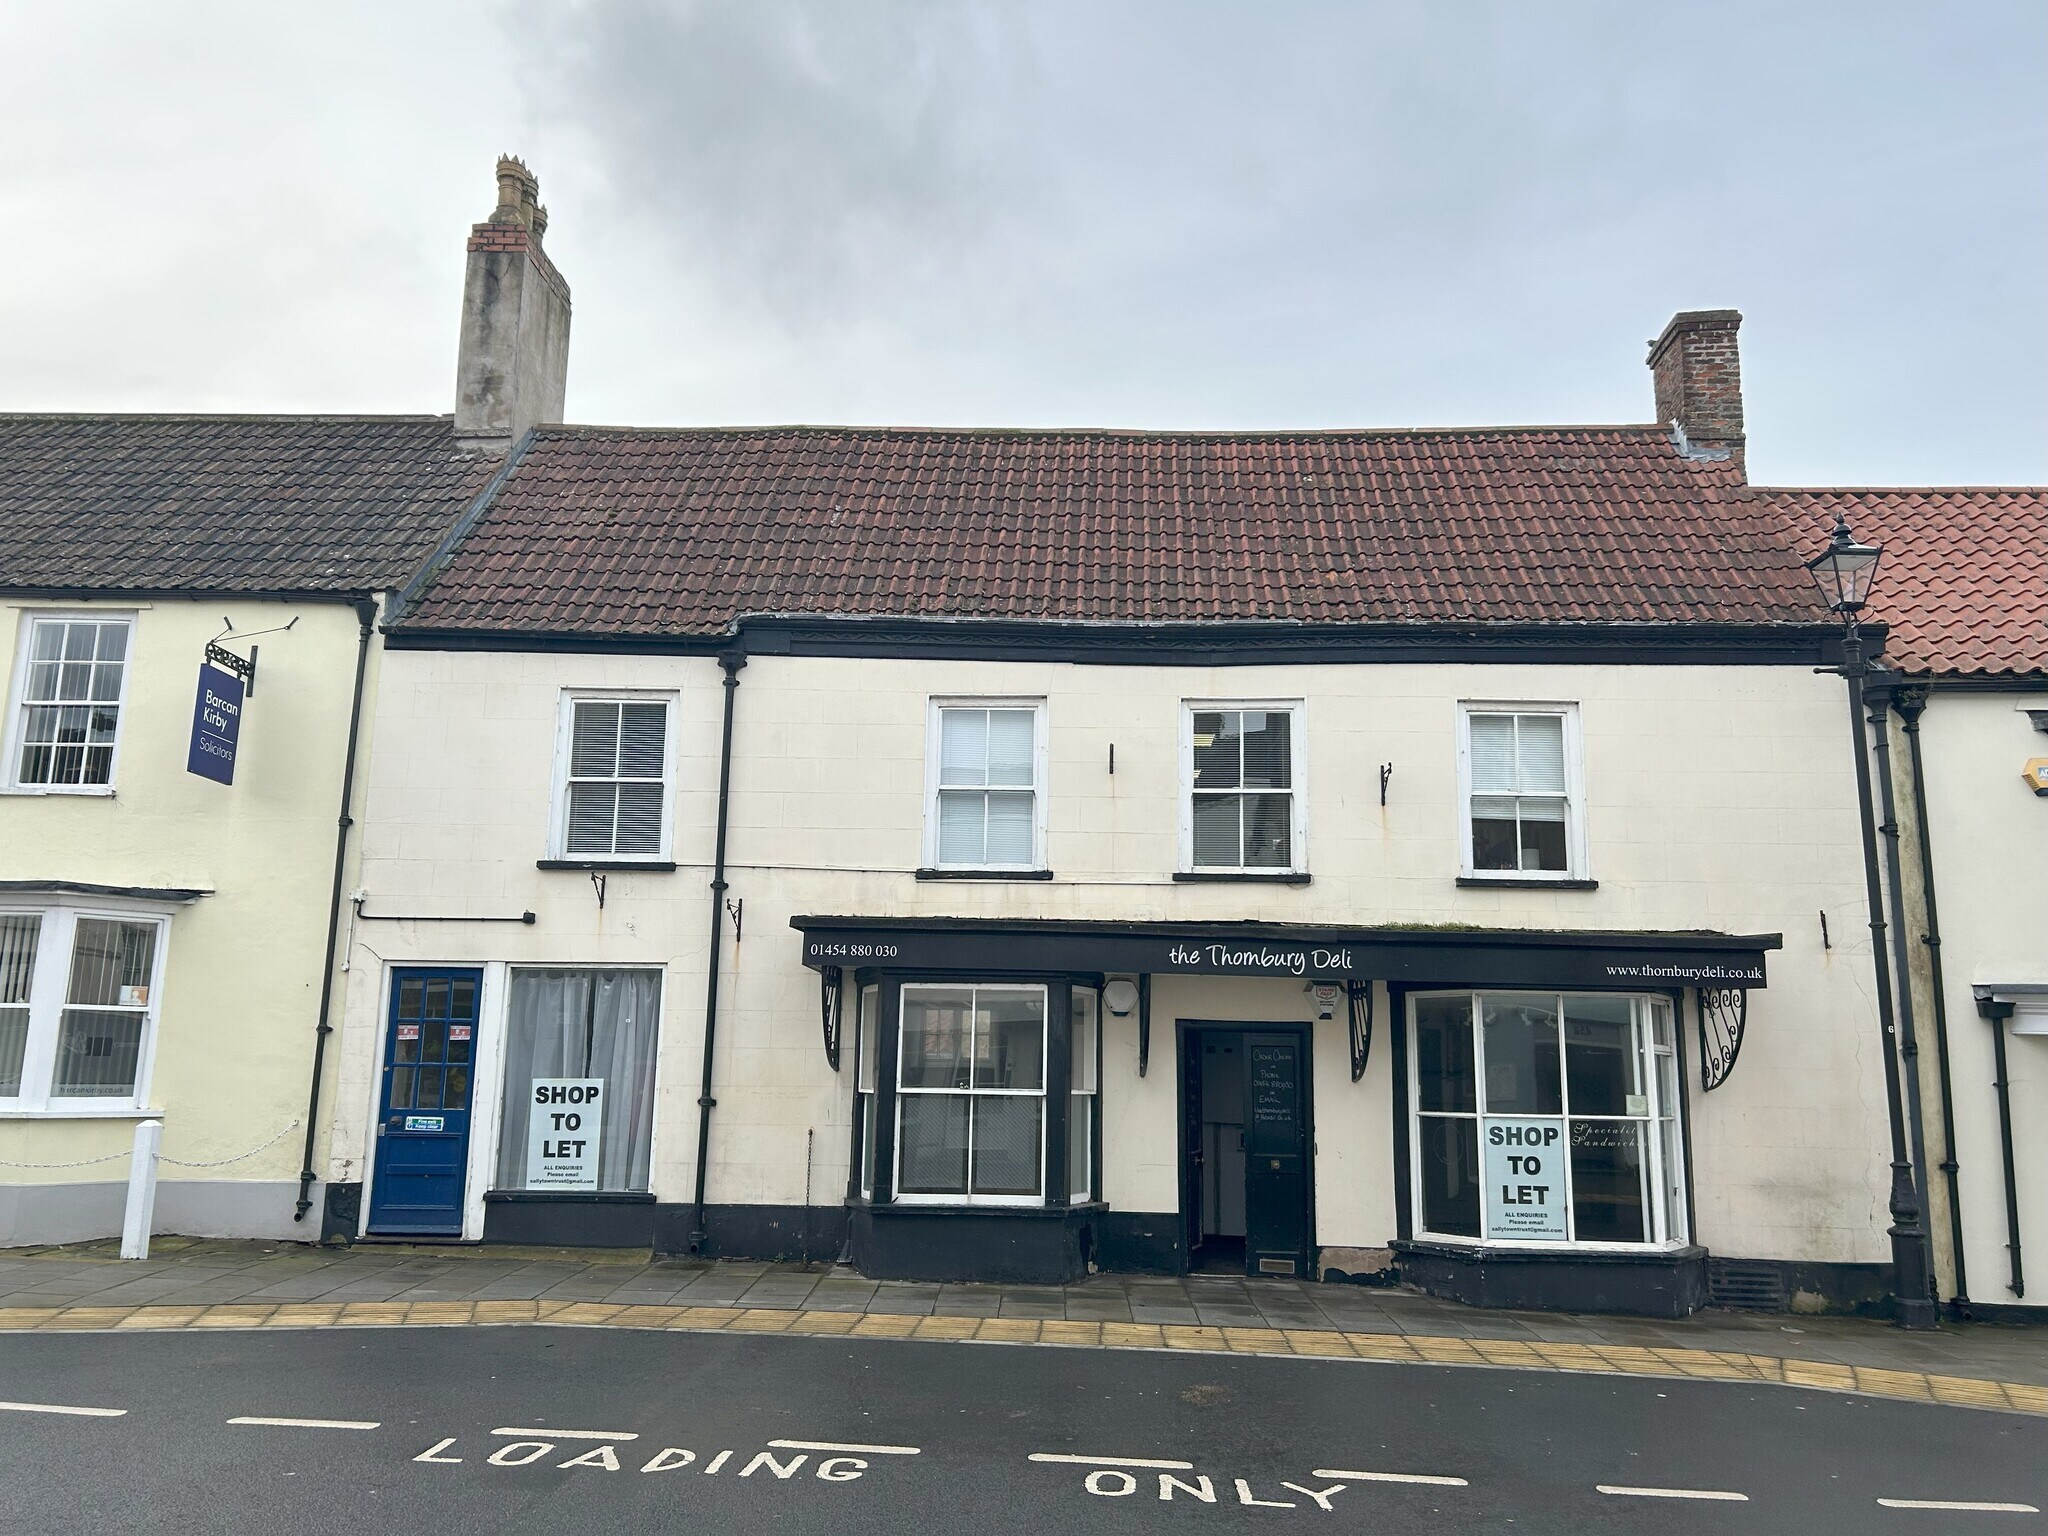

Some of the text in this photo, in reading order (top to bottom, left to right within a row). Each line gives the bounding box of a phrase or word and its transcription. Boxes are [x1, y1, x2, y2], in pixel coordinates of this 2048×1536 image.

[205, 689, 238, 716] Barcan
[203, 706, 228, 732] Kirby
[199, 737, 232, 760] Solicitors
[810, 943, 898, 957] 01454 880 030
[1169, 944, 1353, 975] the Thornbury Deli
[1606, 964, 1763, 980] www.thornburydeli.co.uk
[1888, 1025, 1894, 1033] 6
[535, 1086, 599, 1104] SHOP
[551, 1113, 582, 1131] TO
[1574, 1123, 1637, 1137] Specialit
[1489, 1126, 1559, 1146] SHOP
[543, 1140, 586, 1158] LET
[1507, 1156, 1541, 1175] TO
[1502, 1185, 1549, 1205] LET
[412, 1438, 1347, 1511] LOADING ONLY
